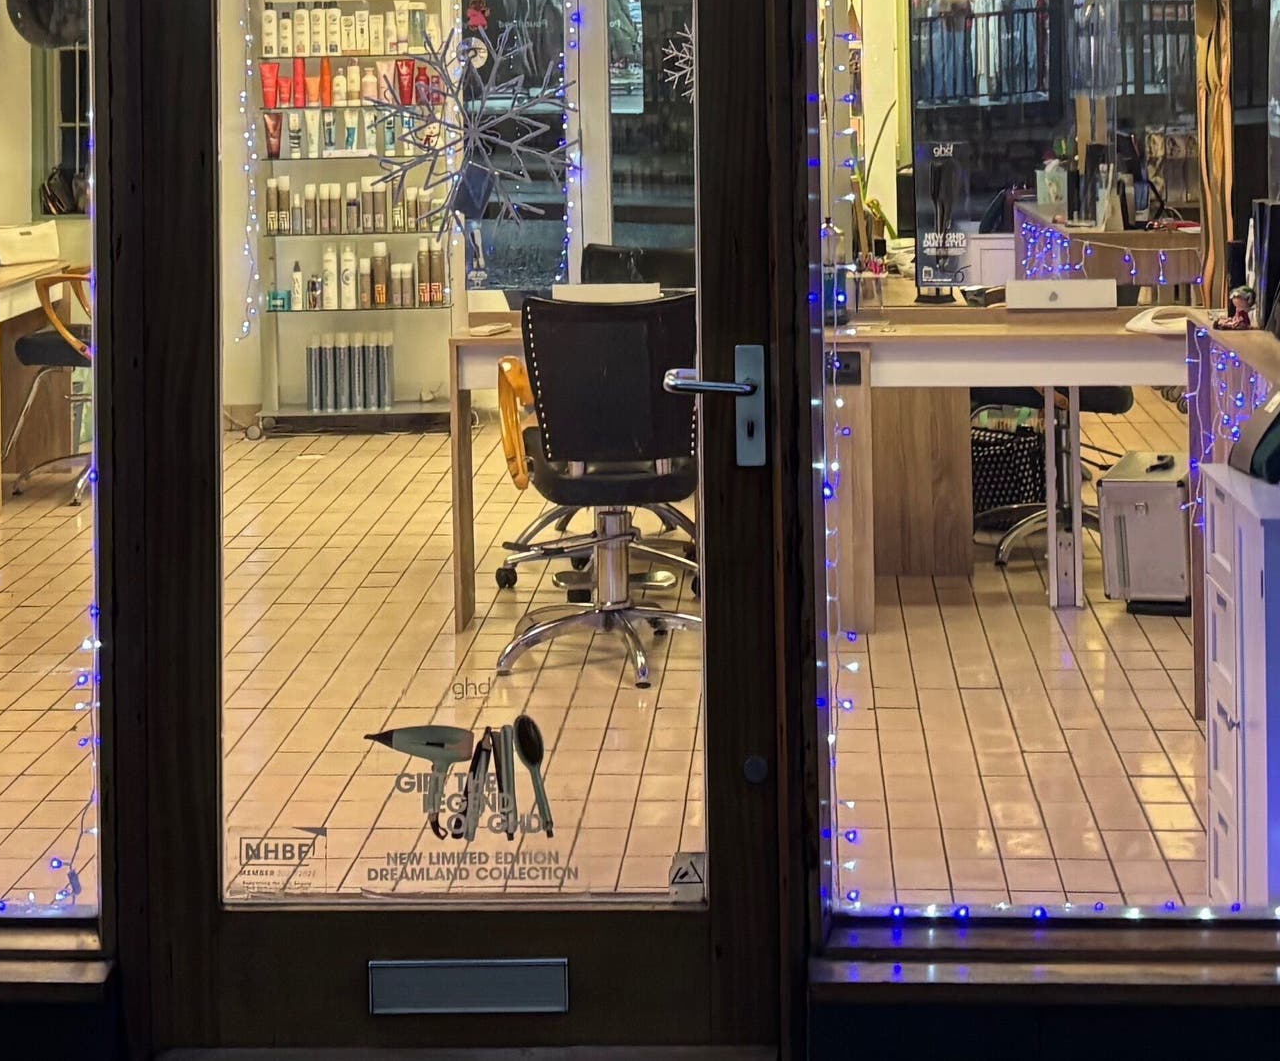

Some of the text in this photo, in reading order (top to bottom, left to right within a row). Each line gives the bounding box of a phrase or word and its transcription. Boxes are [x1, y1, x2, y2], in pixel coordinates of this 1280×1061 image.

[452, 676, 491, 700] ghd
[386, 851, 560, 866] NEW LIMITED EDITION
[367, 867, 580, 882] DREAMLAND COLLECTION
